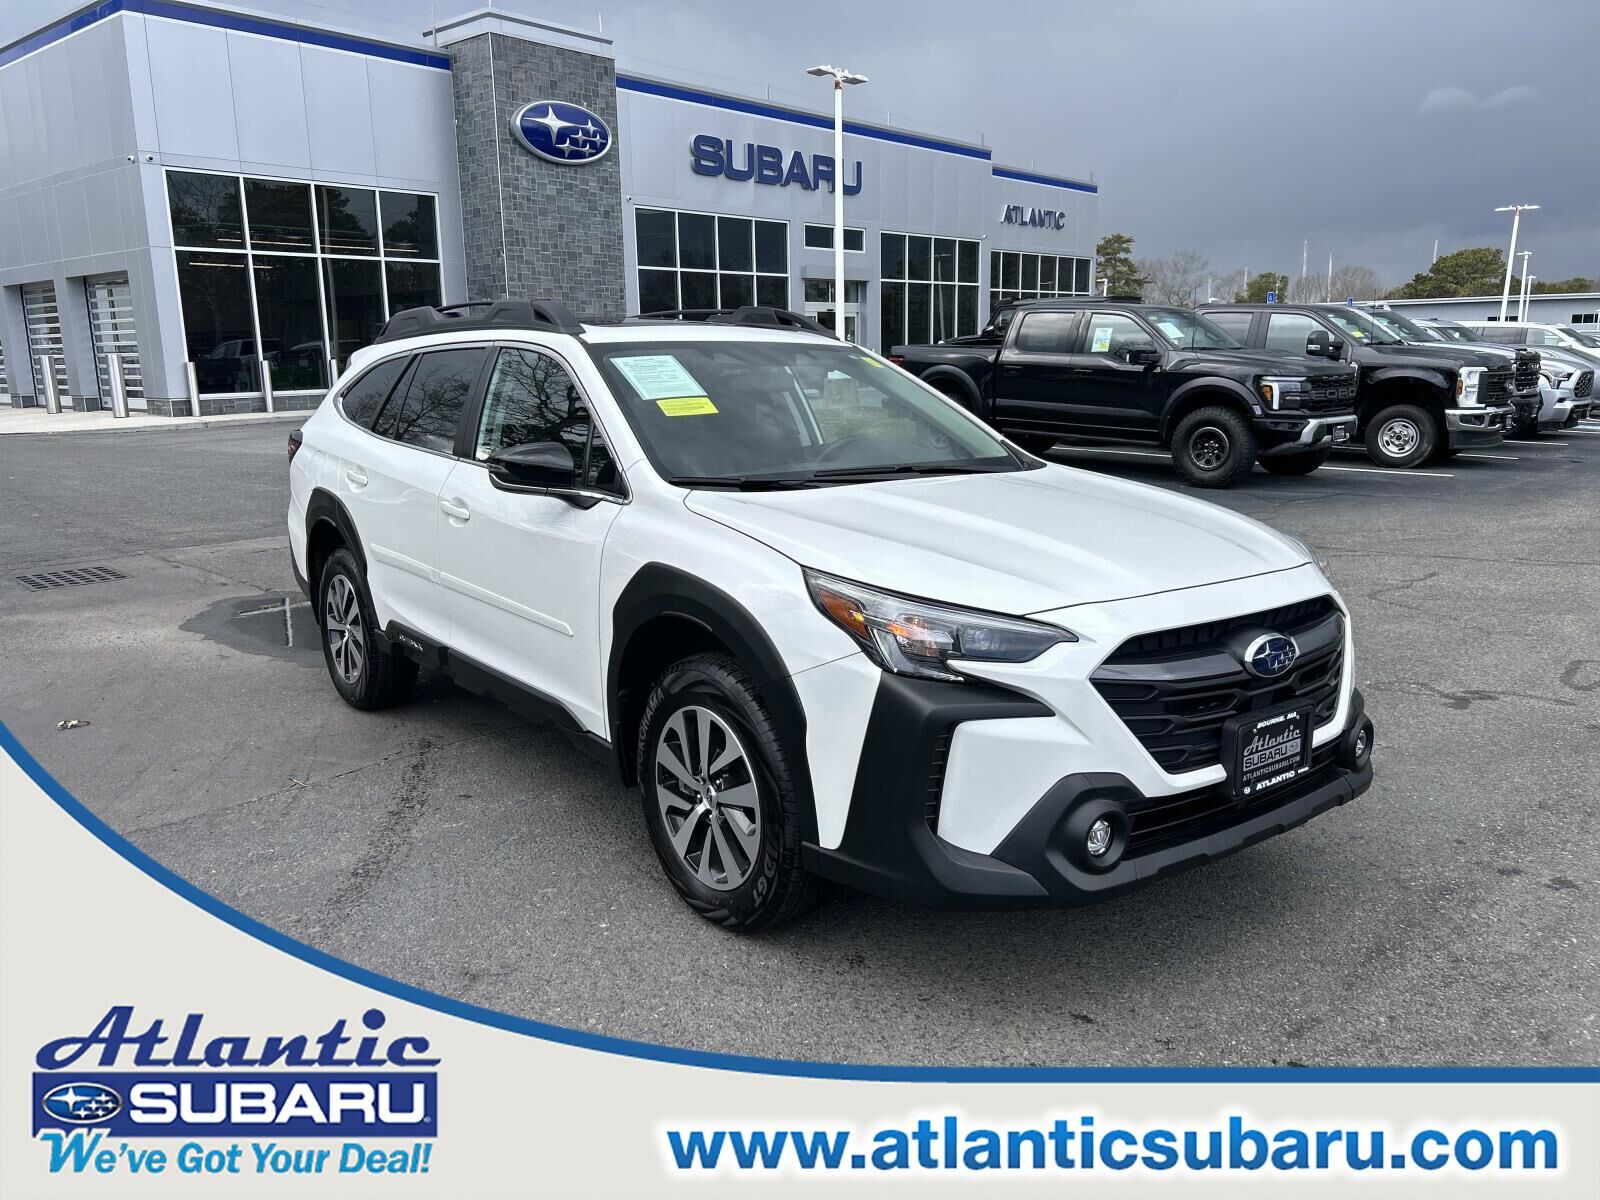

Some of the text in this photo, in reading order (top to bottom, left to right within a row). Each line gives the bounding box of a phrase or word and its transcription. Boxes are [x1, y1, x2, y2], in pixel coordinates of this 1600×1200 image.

[691, 134, 862, 196] SUBARU
[1000, 204, 1066, 230] ATLANTIC
[1243, 724, 1302, 756] Atlantic
[1244, 743, 1289, 769] SUBARU
[1255, 770, 1296, 791] ATLANTIC
